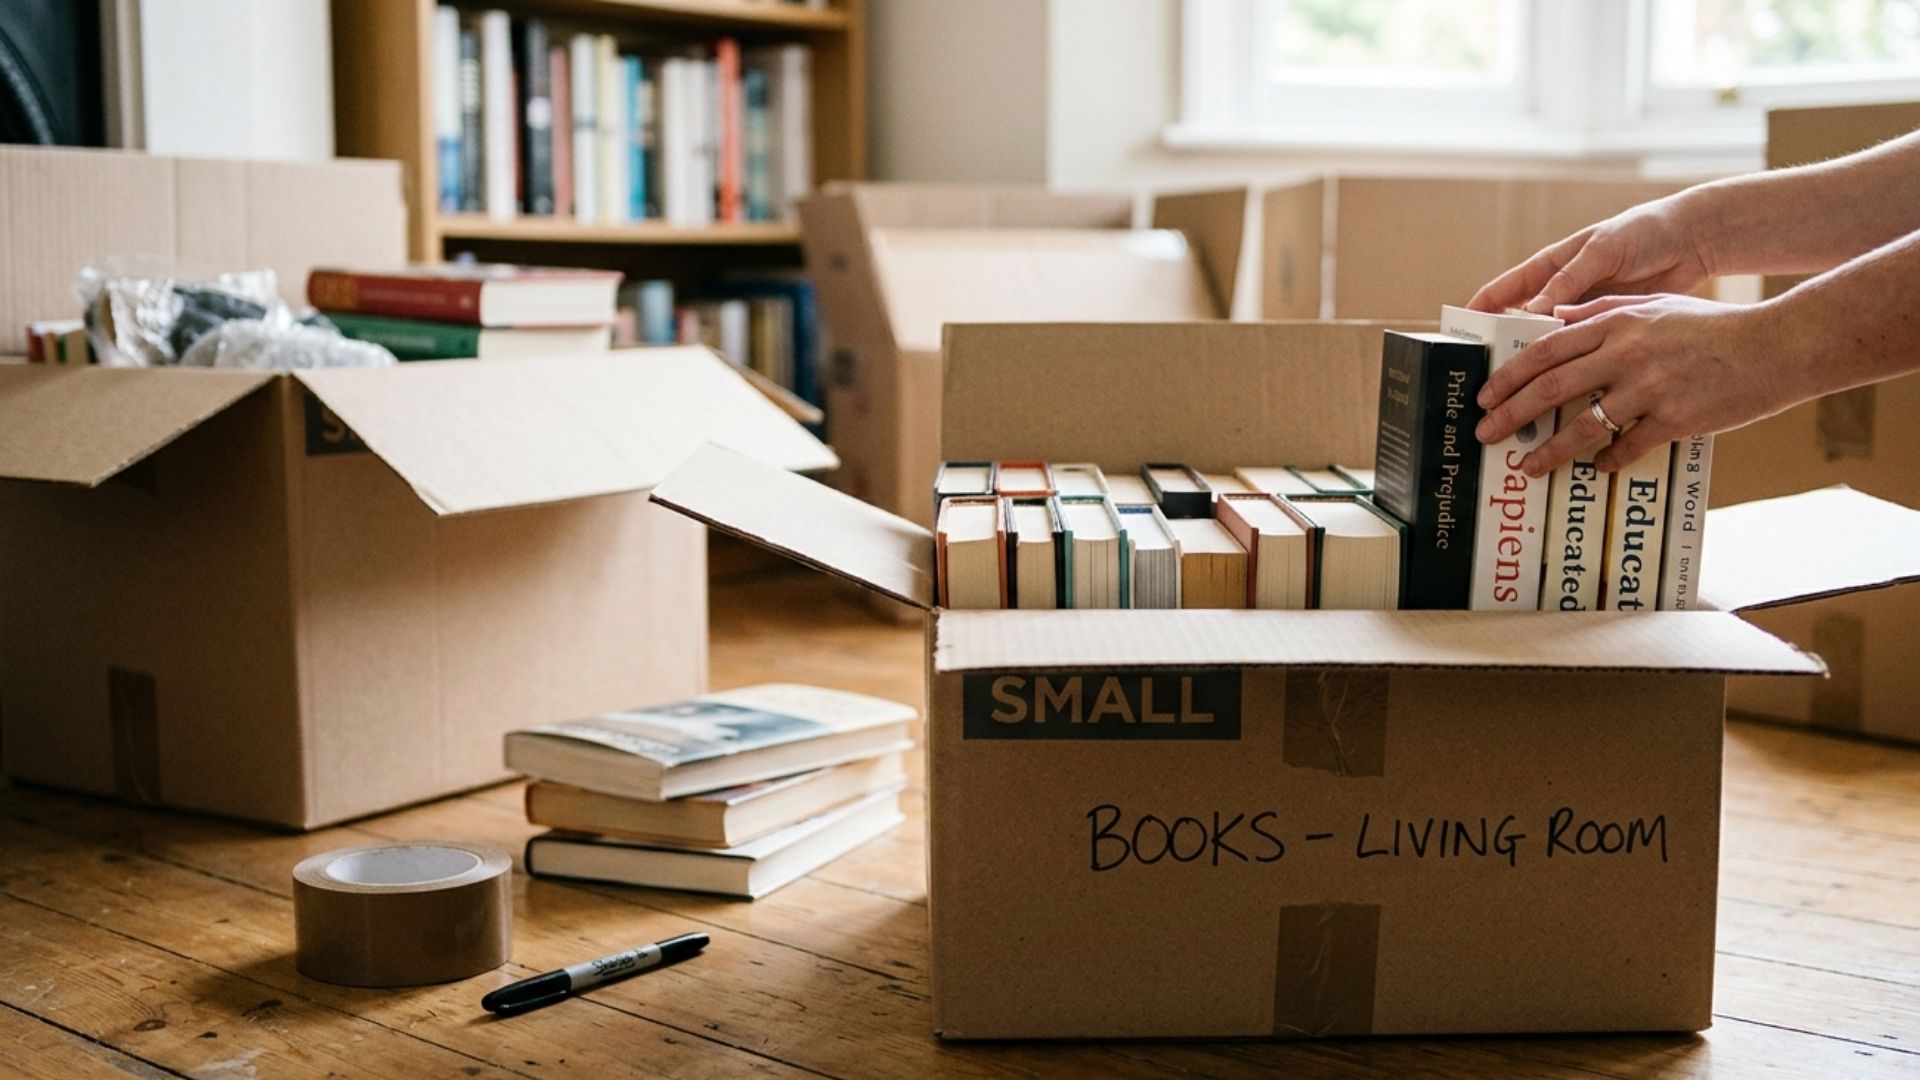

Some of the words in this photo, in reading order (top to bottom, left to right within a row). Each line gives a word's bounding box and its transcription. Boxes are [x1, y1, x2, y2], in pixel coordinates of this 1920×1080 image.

[1446, 370, 1466, 419] Pride
[1442, 424, 1461, 457] and
[1434, 464, 1459, 549] Prejudice
[1489, 450, 1535, 602] Sapiens
[1559, 457, 1597, 610] Educated
[1683, 481, 1701, 531] Word
[990, 675, 1215, 723] SMALL
[1087, 804, 1284, 871] BOOKS
[1356, 813, 1527, 867] LIVING
[1546, 806, 1668, 862] ROOM
